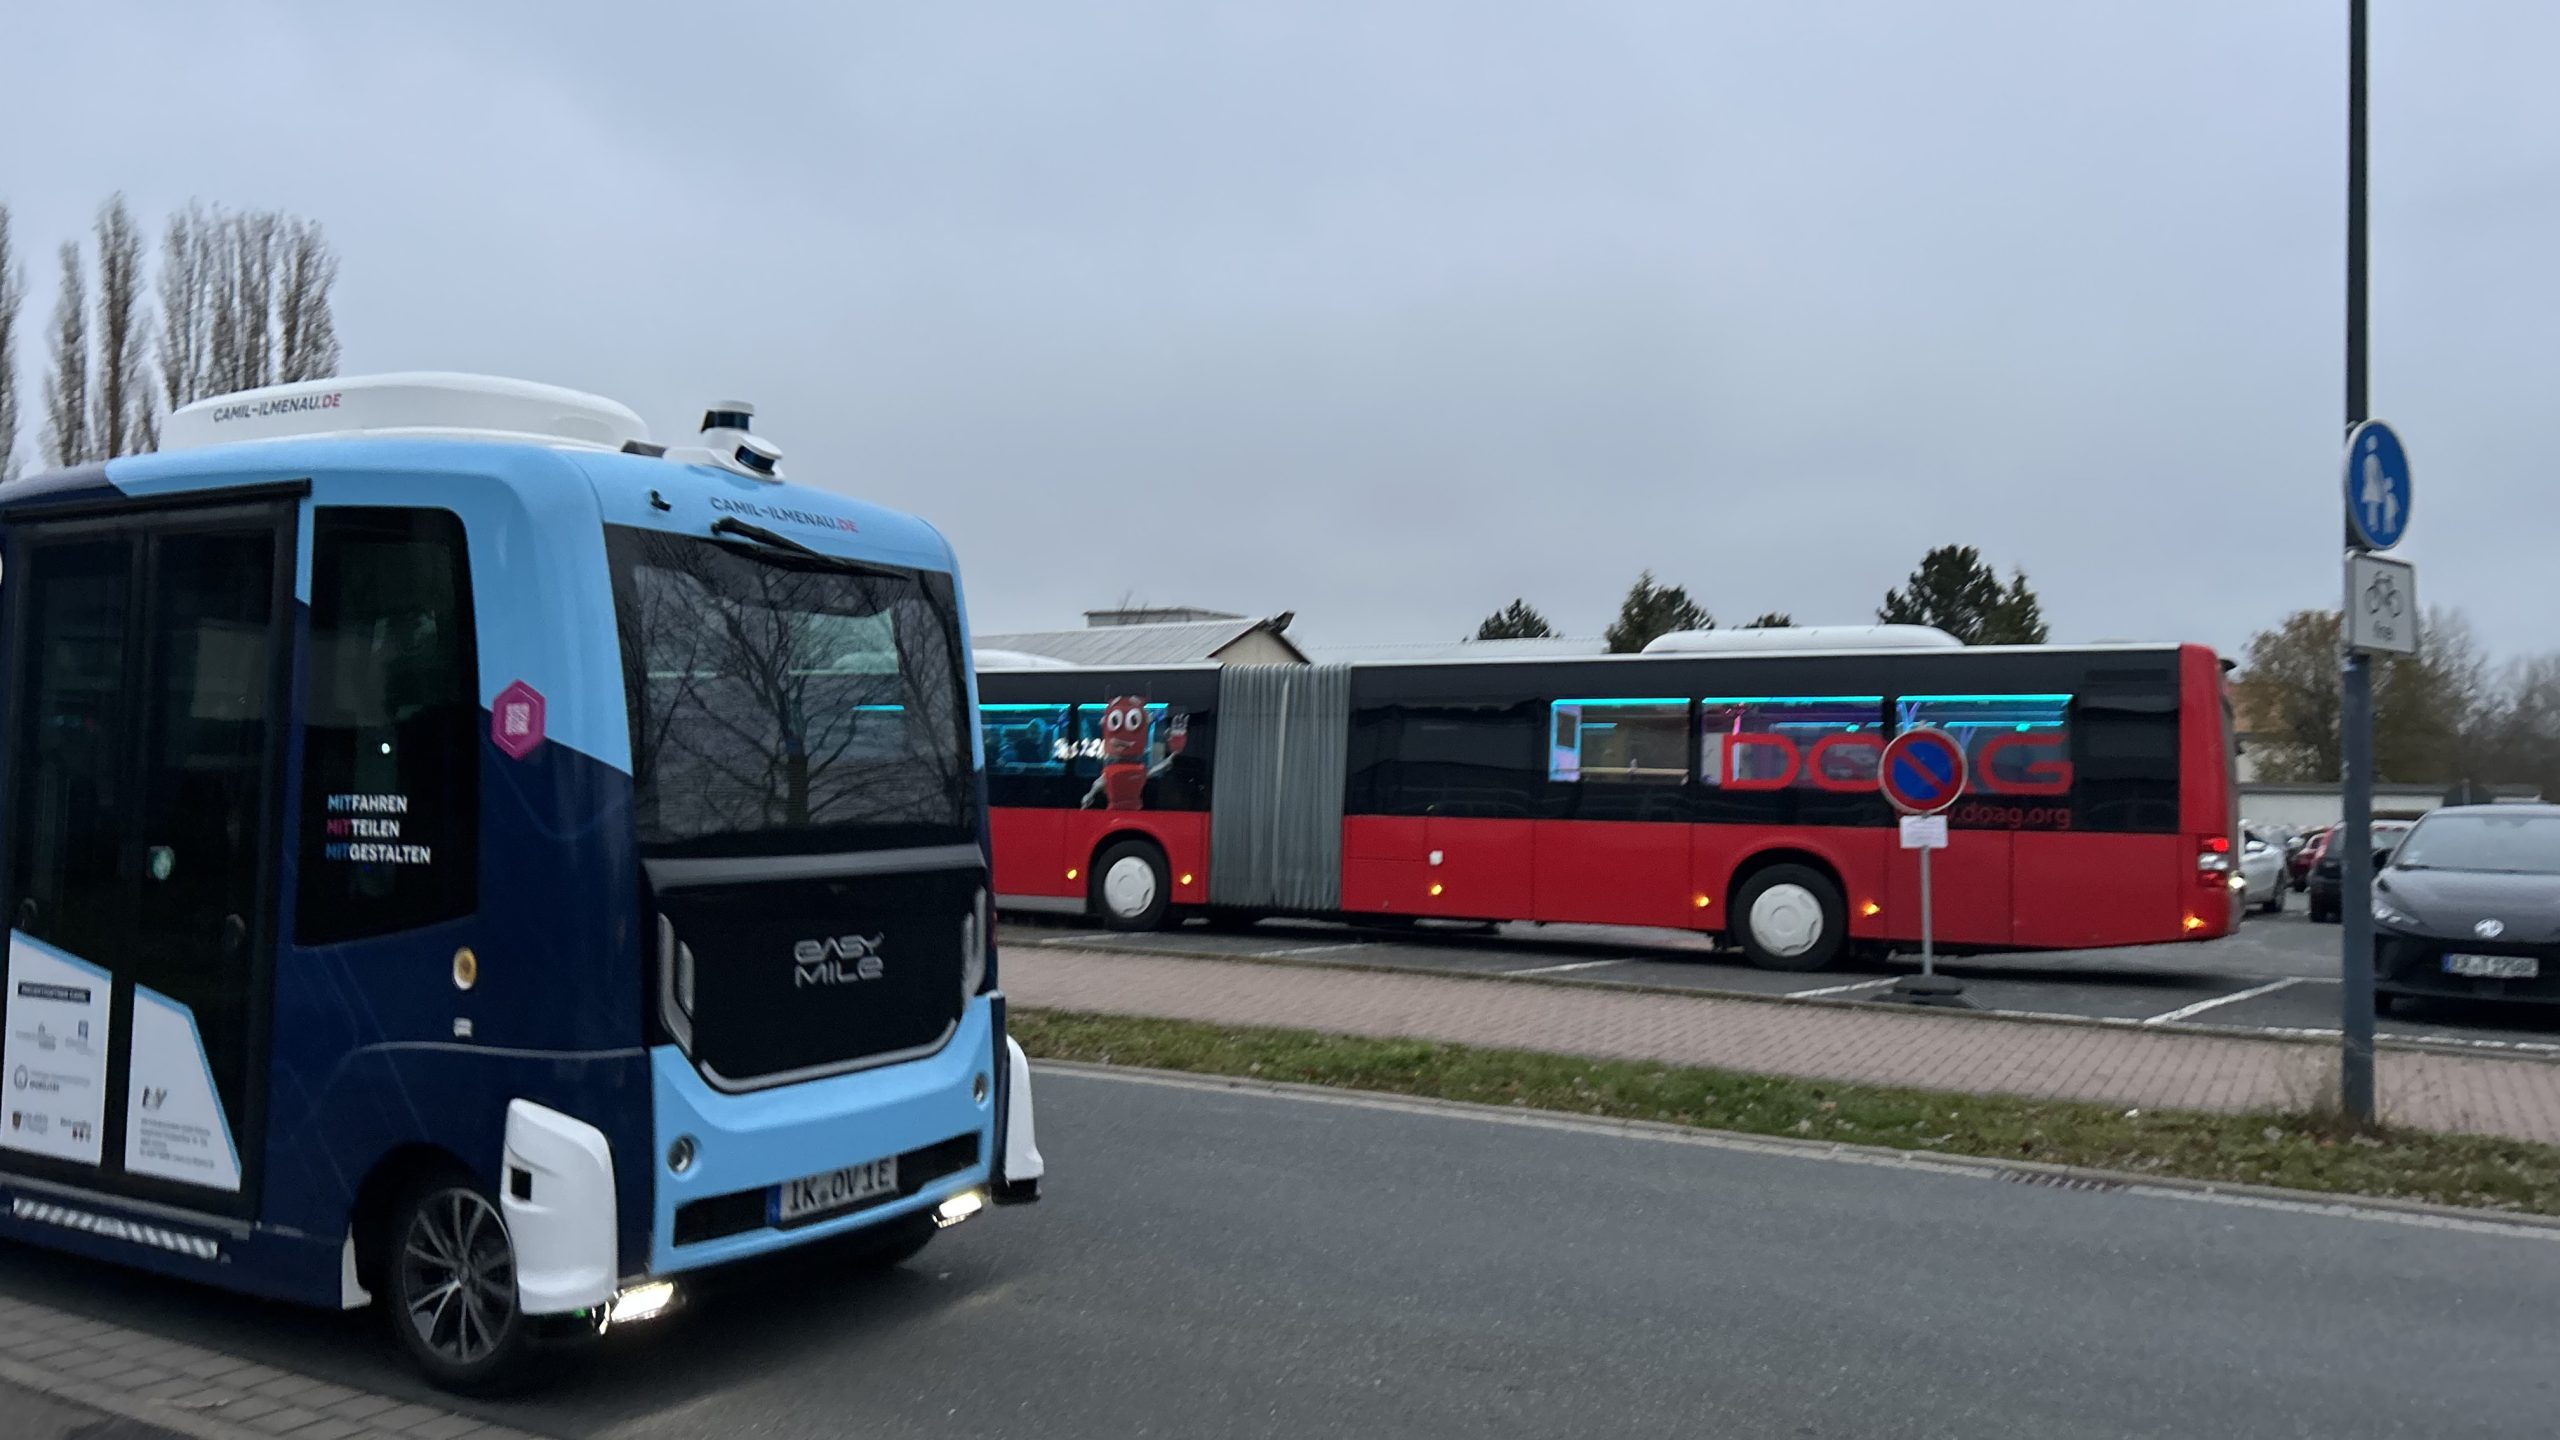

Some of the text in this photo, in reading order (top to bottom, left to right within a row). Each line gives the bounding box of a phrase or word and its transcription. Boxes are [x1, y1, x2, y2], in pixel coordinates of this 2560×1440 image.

[213, 393, 341, 422] CAMIL-ILMENAU.DE
[710, 496, 858, 533] CAMIL-ILMENAU.DE
[1720, 733, 2073, 795] DOG
[327, 794, 408, 813] MITFAHREN
[326, 819, 400, 837] MITTEILEN
[325, 843, 431, 864] MITGESTALTEN
